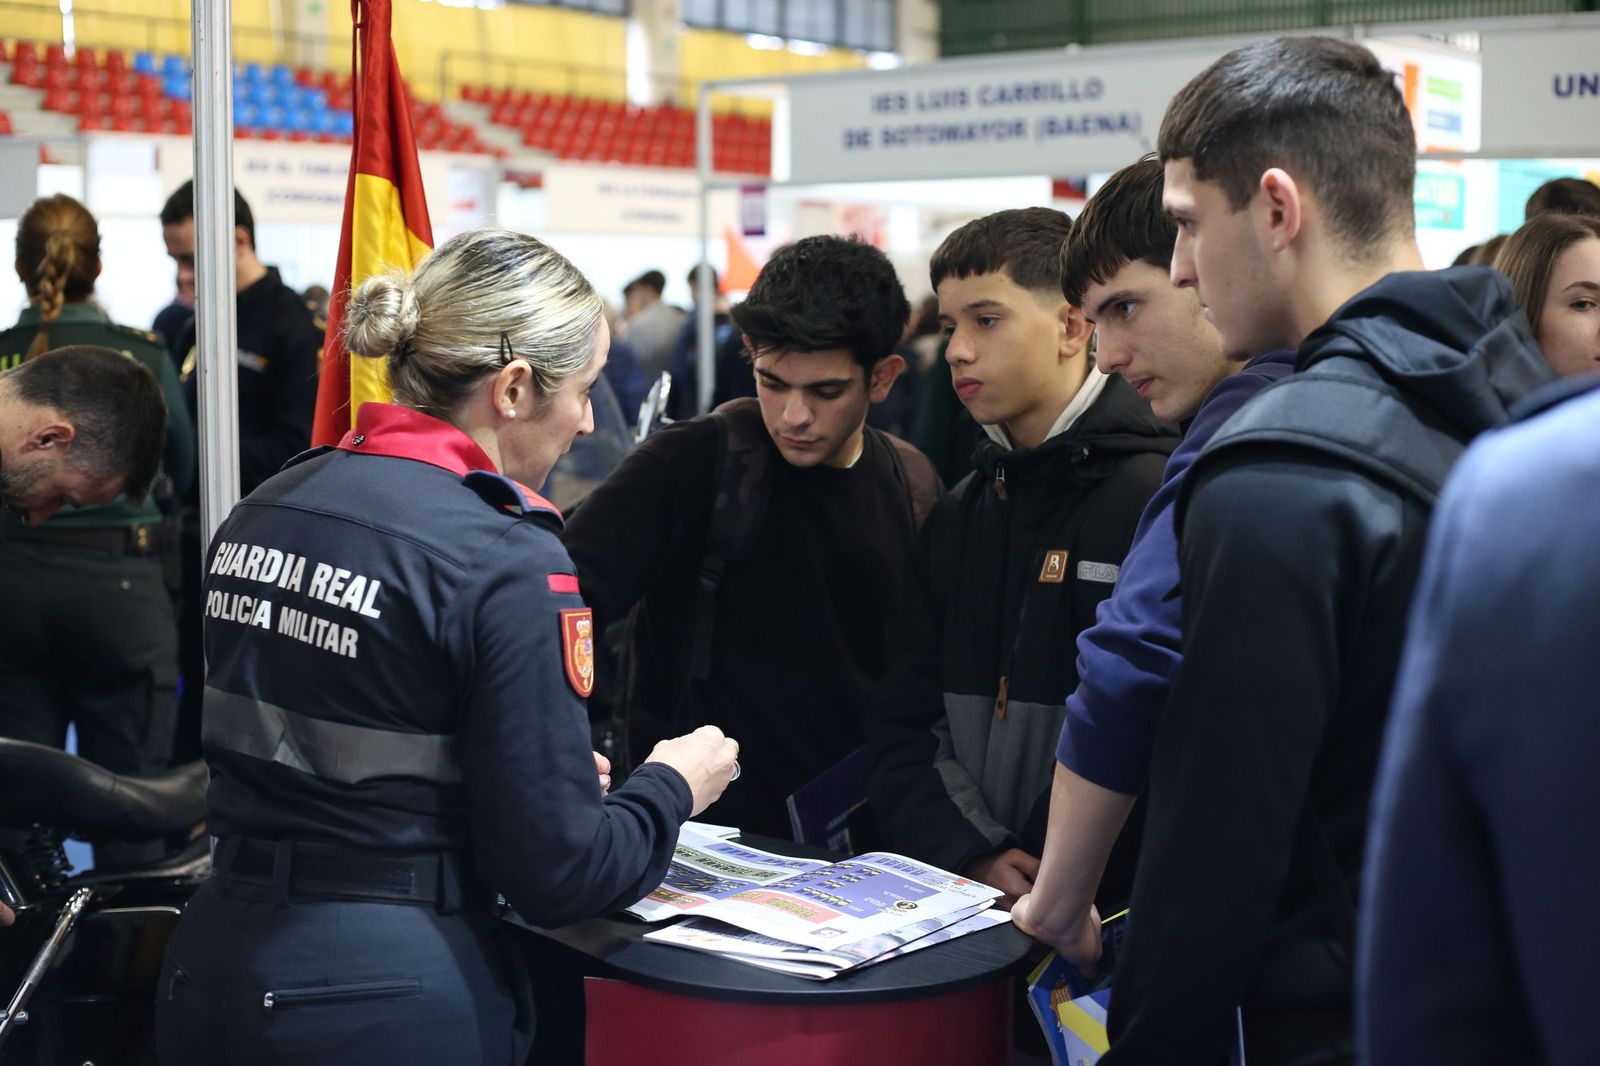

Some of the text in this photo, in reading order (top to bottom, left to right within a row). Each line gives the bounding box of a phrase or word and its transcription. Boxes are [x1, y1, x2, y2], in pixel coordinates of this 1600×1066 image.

[872, 76, 1105, 113] IES LUIS CARRILLO
[843, 110, 1142, 150] DE SOTOMAYOR (BAENA)
[210, 541, 381, 619] GUARDIA REAL
[1082, 562, 1116, 579] FILA
[205, 590, 359, 659] POLICIA MILITAR
